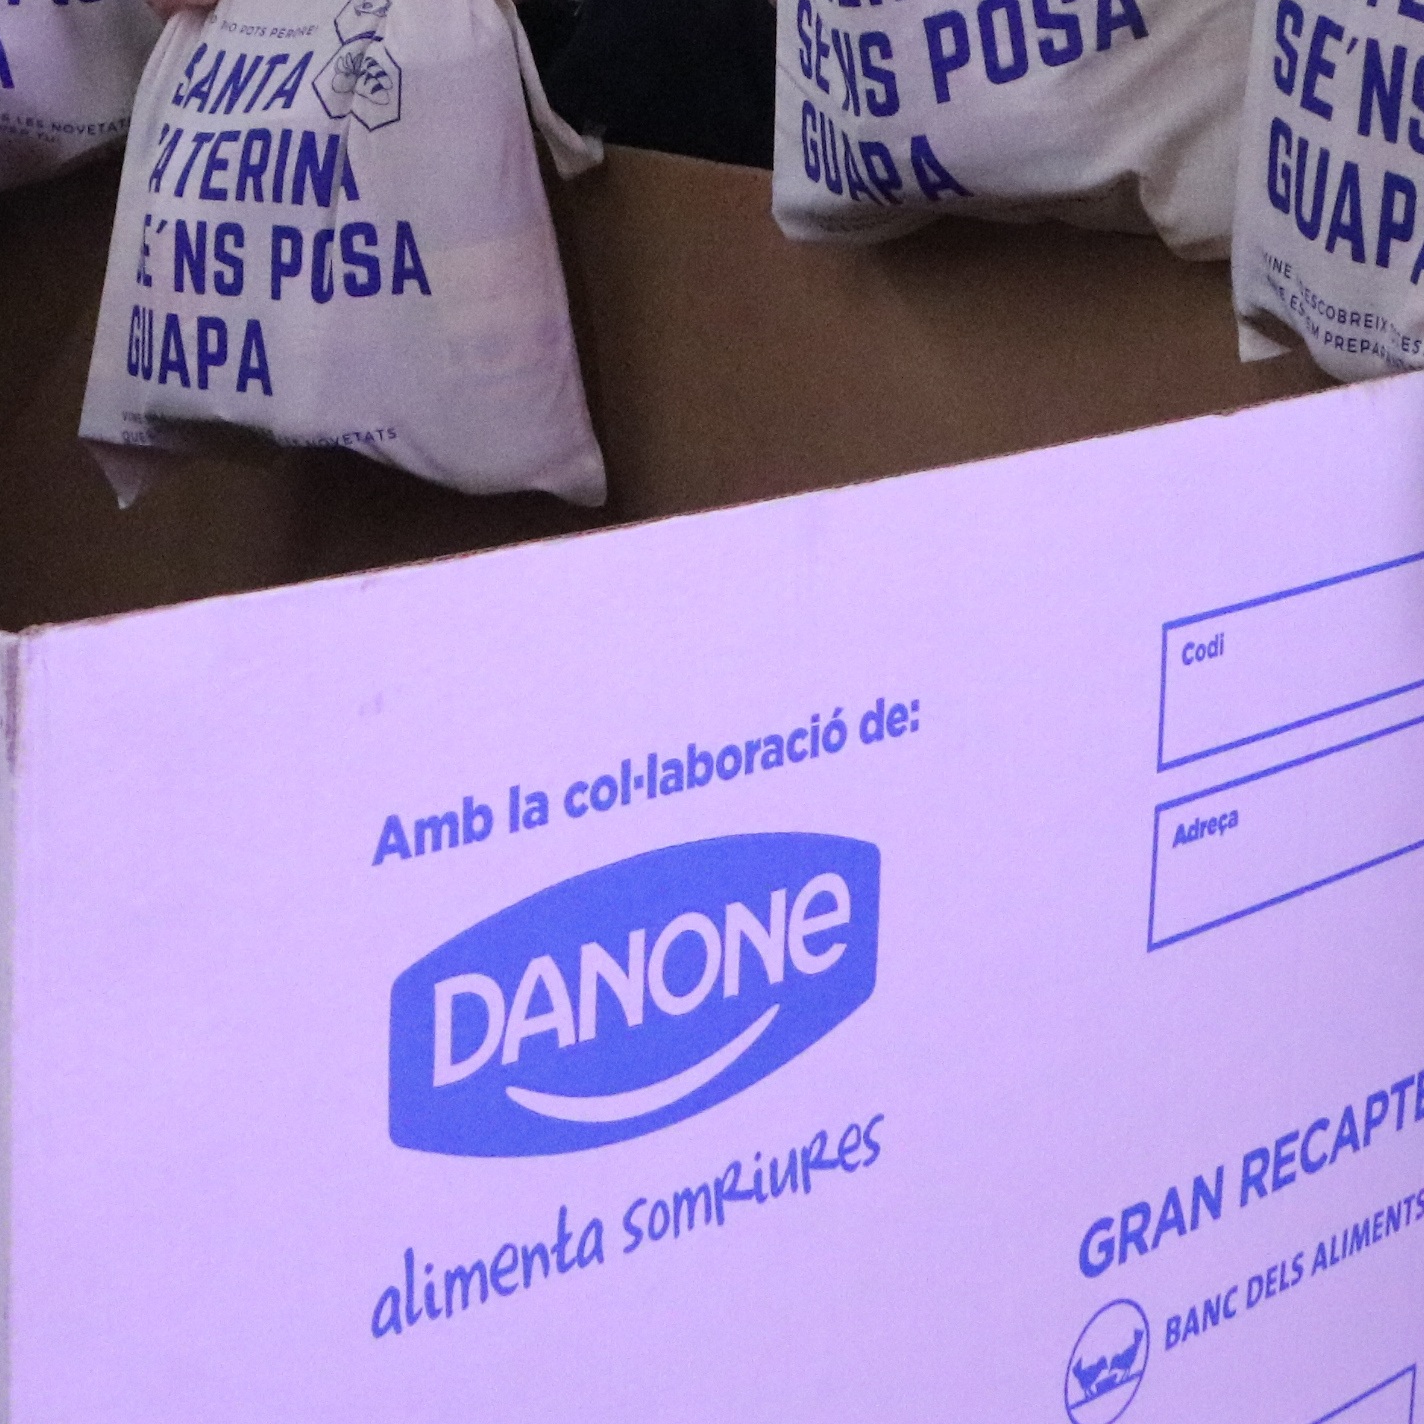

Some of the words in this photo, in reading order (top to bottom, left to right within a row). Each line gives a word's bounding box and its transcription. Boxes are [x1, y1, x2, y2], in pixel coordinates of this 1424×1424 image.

[172, 42, 315, 115] SANTA
[801, 99, 976, 207] GUAPA
[126, 303, 274, 397] GUAPA
[1182, 631, 1225, 666] Codi
[371, 795, 494, 867] Amb
[508, 785, 550, 833] la
[858, 696, 921, 747] de:
[1171, 808, 1240, 849] Adreça
[370, 1203, 605, 1340] alimenta
[1078, 1164, 1225, 1279] GRAN
[1164, 1284, 1238, 1351] BANC
[1246, 1250, 1304, 1310] DELS
